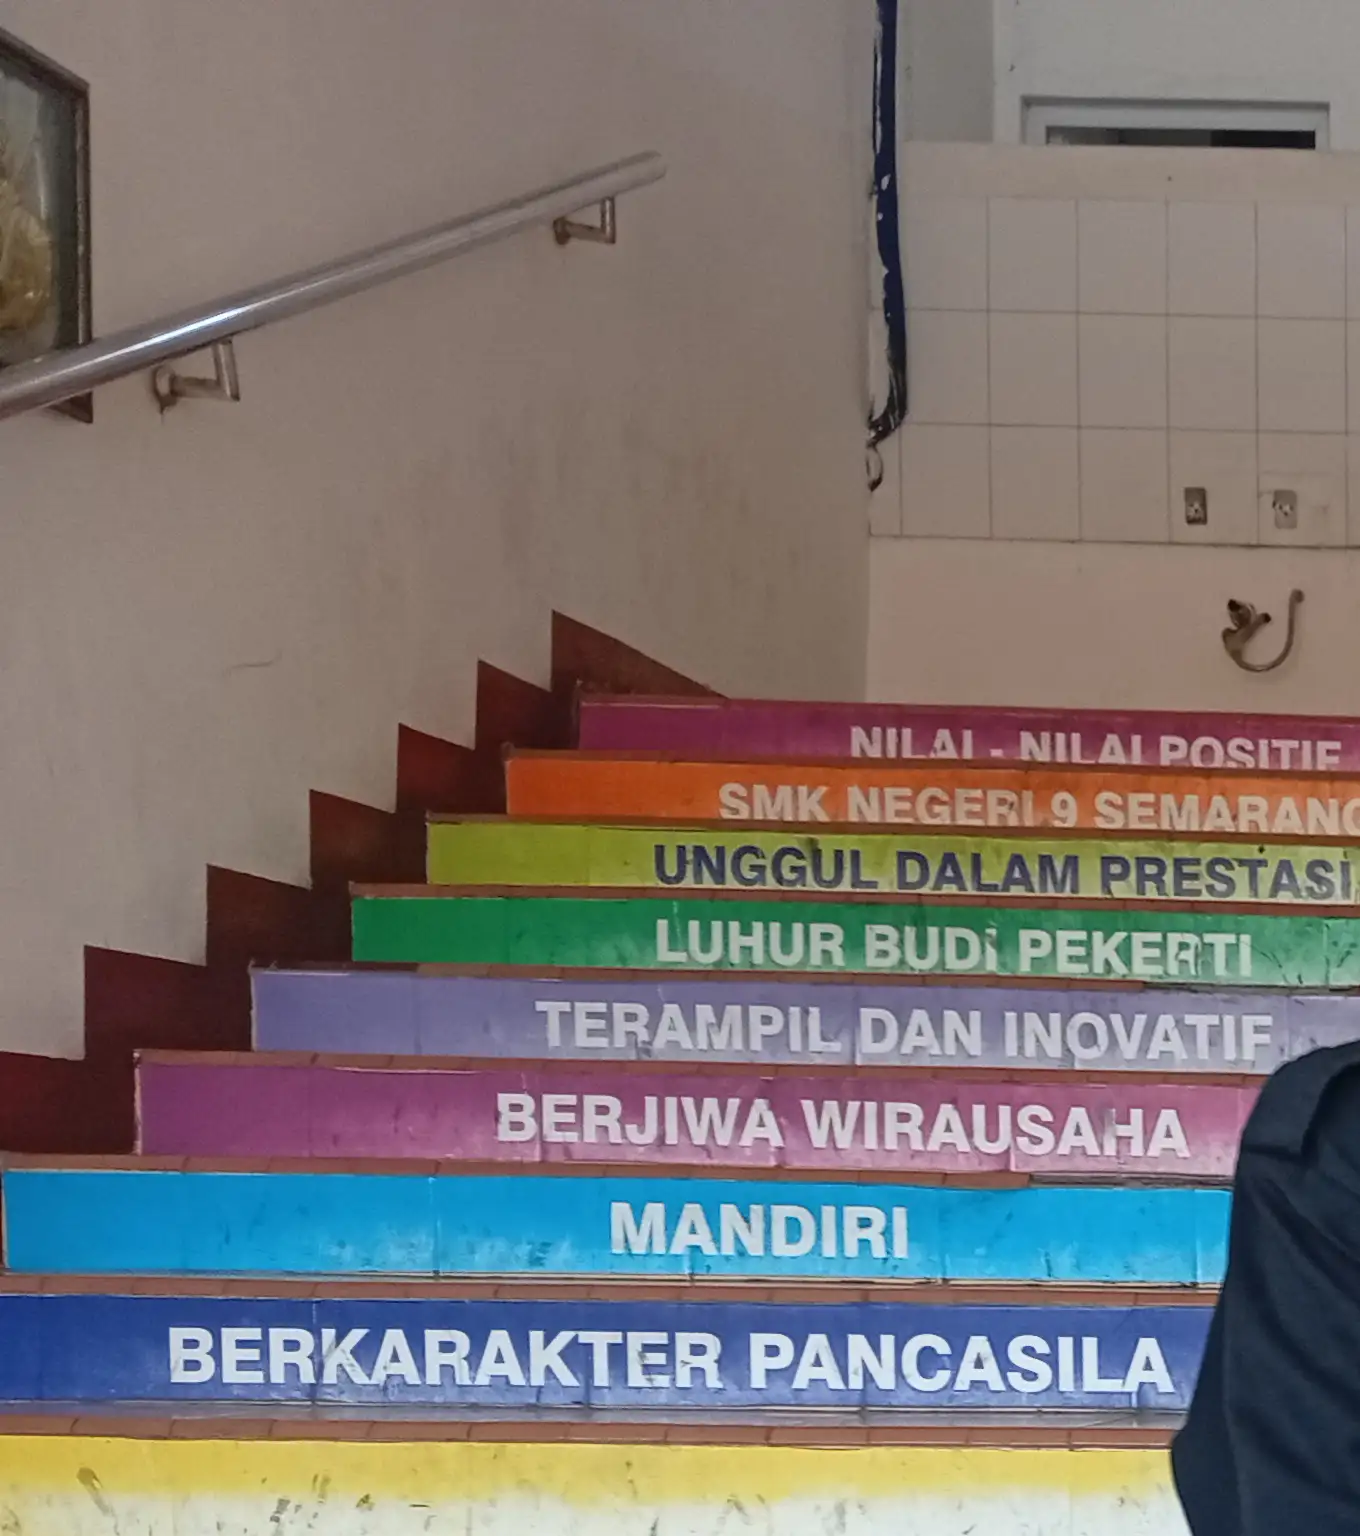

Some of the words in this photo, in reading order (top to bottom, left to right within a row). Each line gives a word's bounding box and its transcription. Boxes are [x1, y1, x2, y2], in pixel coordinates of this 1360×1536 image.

[850, 725, 974, 760] NILAI
[1019, 730, 1143, 764] NILAI
[1159, 734, 1342, 771] POSITIF
[718, 782, 832, 823] SMK
[846, 784, 1036, 828] NEGERI
[1050, 790, 1078, 829] 9
[653, 844, 880, 891] UNGGUL
[895, 850, 1080, 895] DALAM
[1100, 855, 1352, 900] PRESTASI
[655, 918, 846, 968] LUHUR
[864, 923, 998, 973] BUDI
[1017, 929, 1252, 978] PEKERTI
[534, 1000, 842, 1055] TERAMPIL
[858, 1007, 982, 1058] DAN
[1004, 1011, 1274, 1062] INOVATIF
[496, 1093, 785, 1150] BERJIWA
[800, 1099, 1191, 1160] WIRAUSAHA
[610, 1201, 910, 1260] MANDIRI
[168, 1326, 724, 1390] BERKARAKTER
[748, 1332, 1175, 1394] PANCASILA
